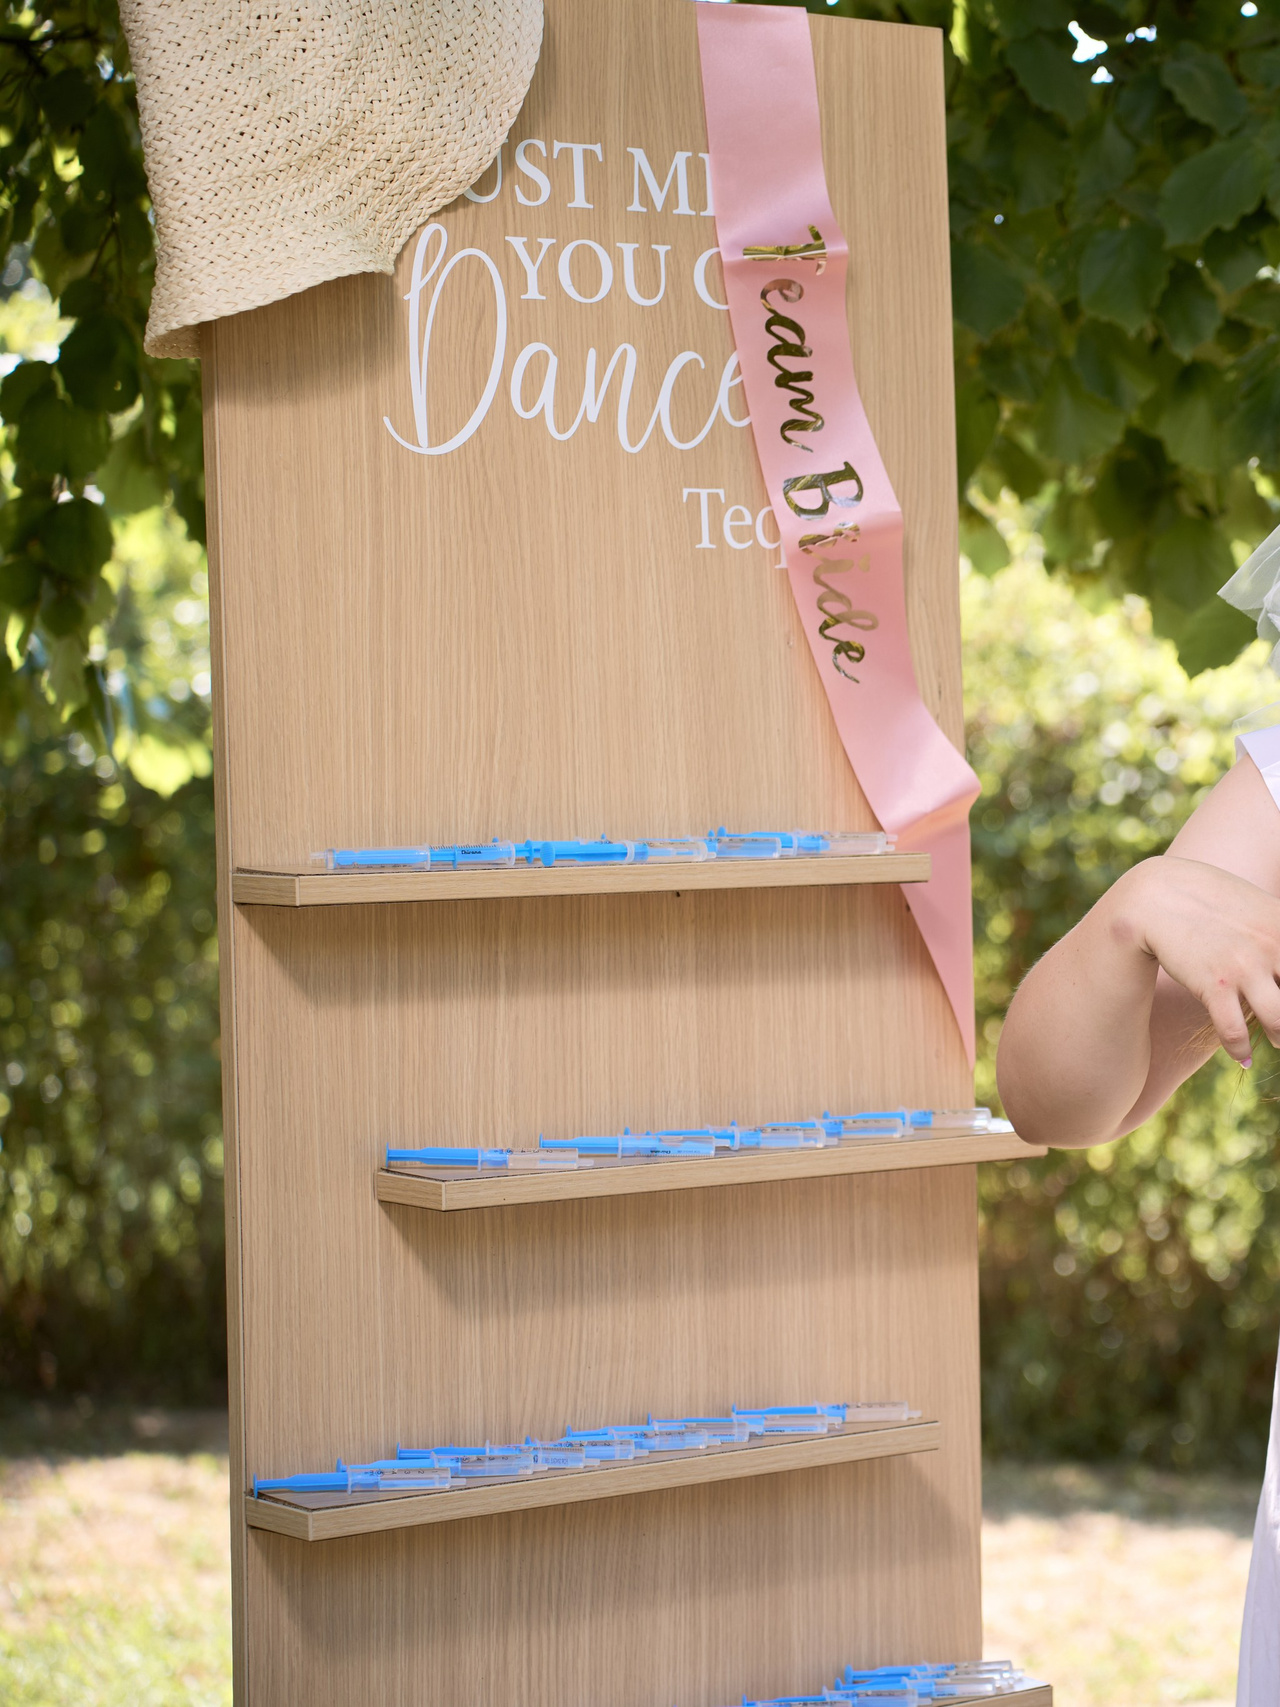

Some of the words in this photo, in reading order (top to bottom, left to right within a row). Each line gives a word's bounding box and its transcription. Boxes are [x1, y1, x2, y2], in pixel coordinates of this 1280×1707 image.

[463, 138, 603, 209] UST
[383, 222, 753, 455] Dance
[505, 236, 672, 306] YOU
[742, 224, 828, 453] Team
[682, 488, 789, 569] Teq
[782, 461, 879, 684] Bride
